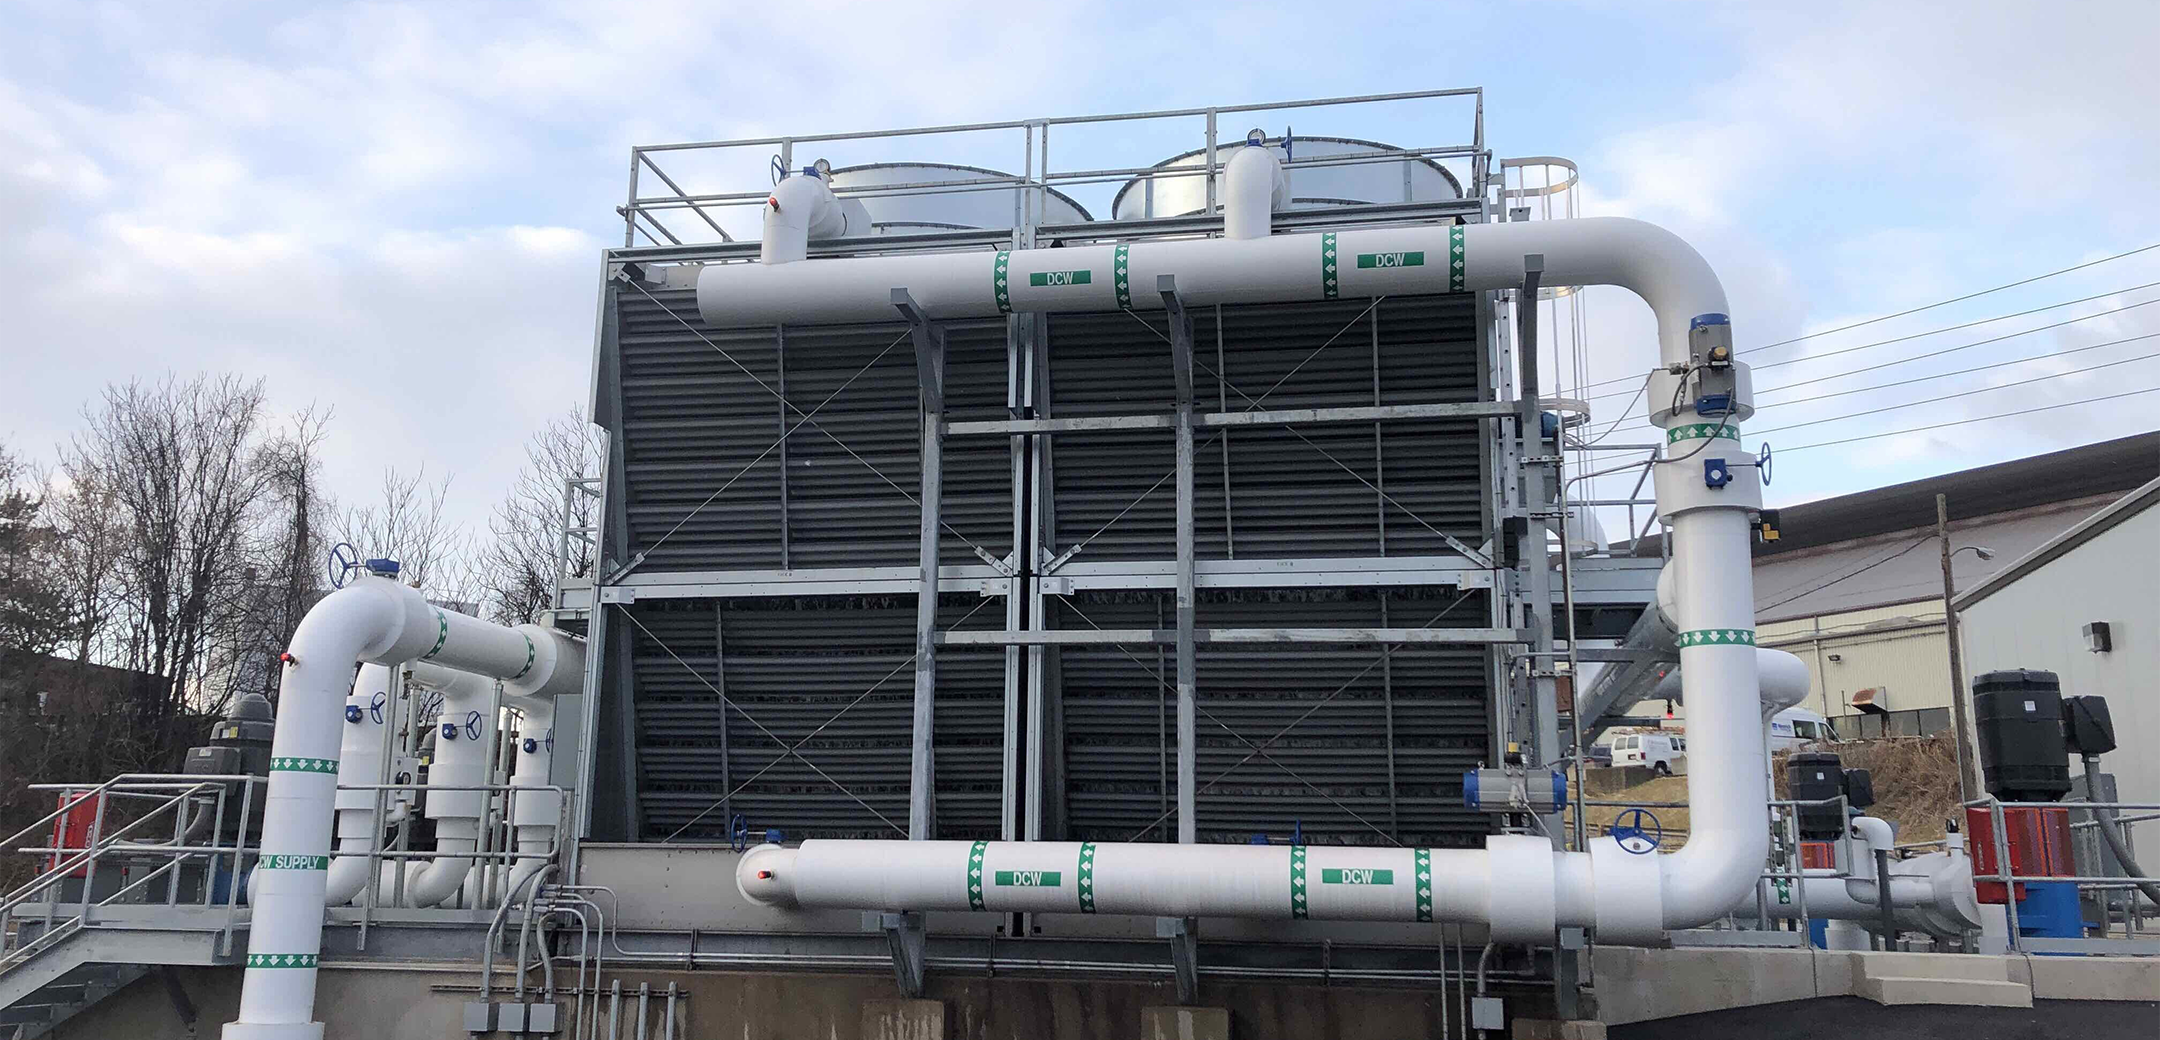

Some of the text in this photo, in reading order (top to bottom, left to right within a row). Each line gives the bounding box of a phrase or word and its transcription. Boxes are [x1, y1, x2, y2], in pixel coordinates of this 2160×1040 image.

[1376, 253, 1405, 267] DCW
[1047, 272, 1073, 285] DCW
[275, 855, 319, 869] SUPPLY
[1013, 871, 1042, 886] DCW
[1342, 869, 1373, 884] DCW
